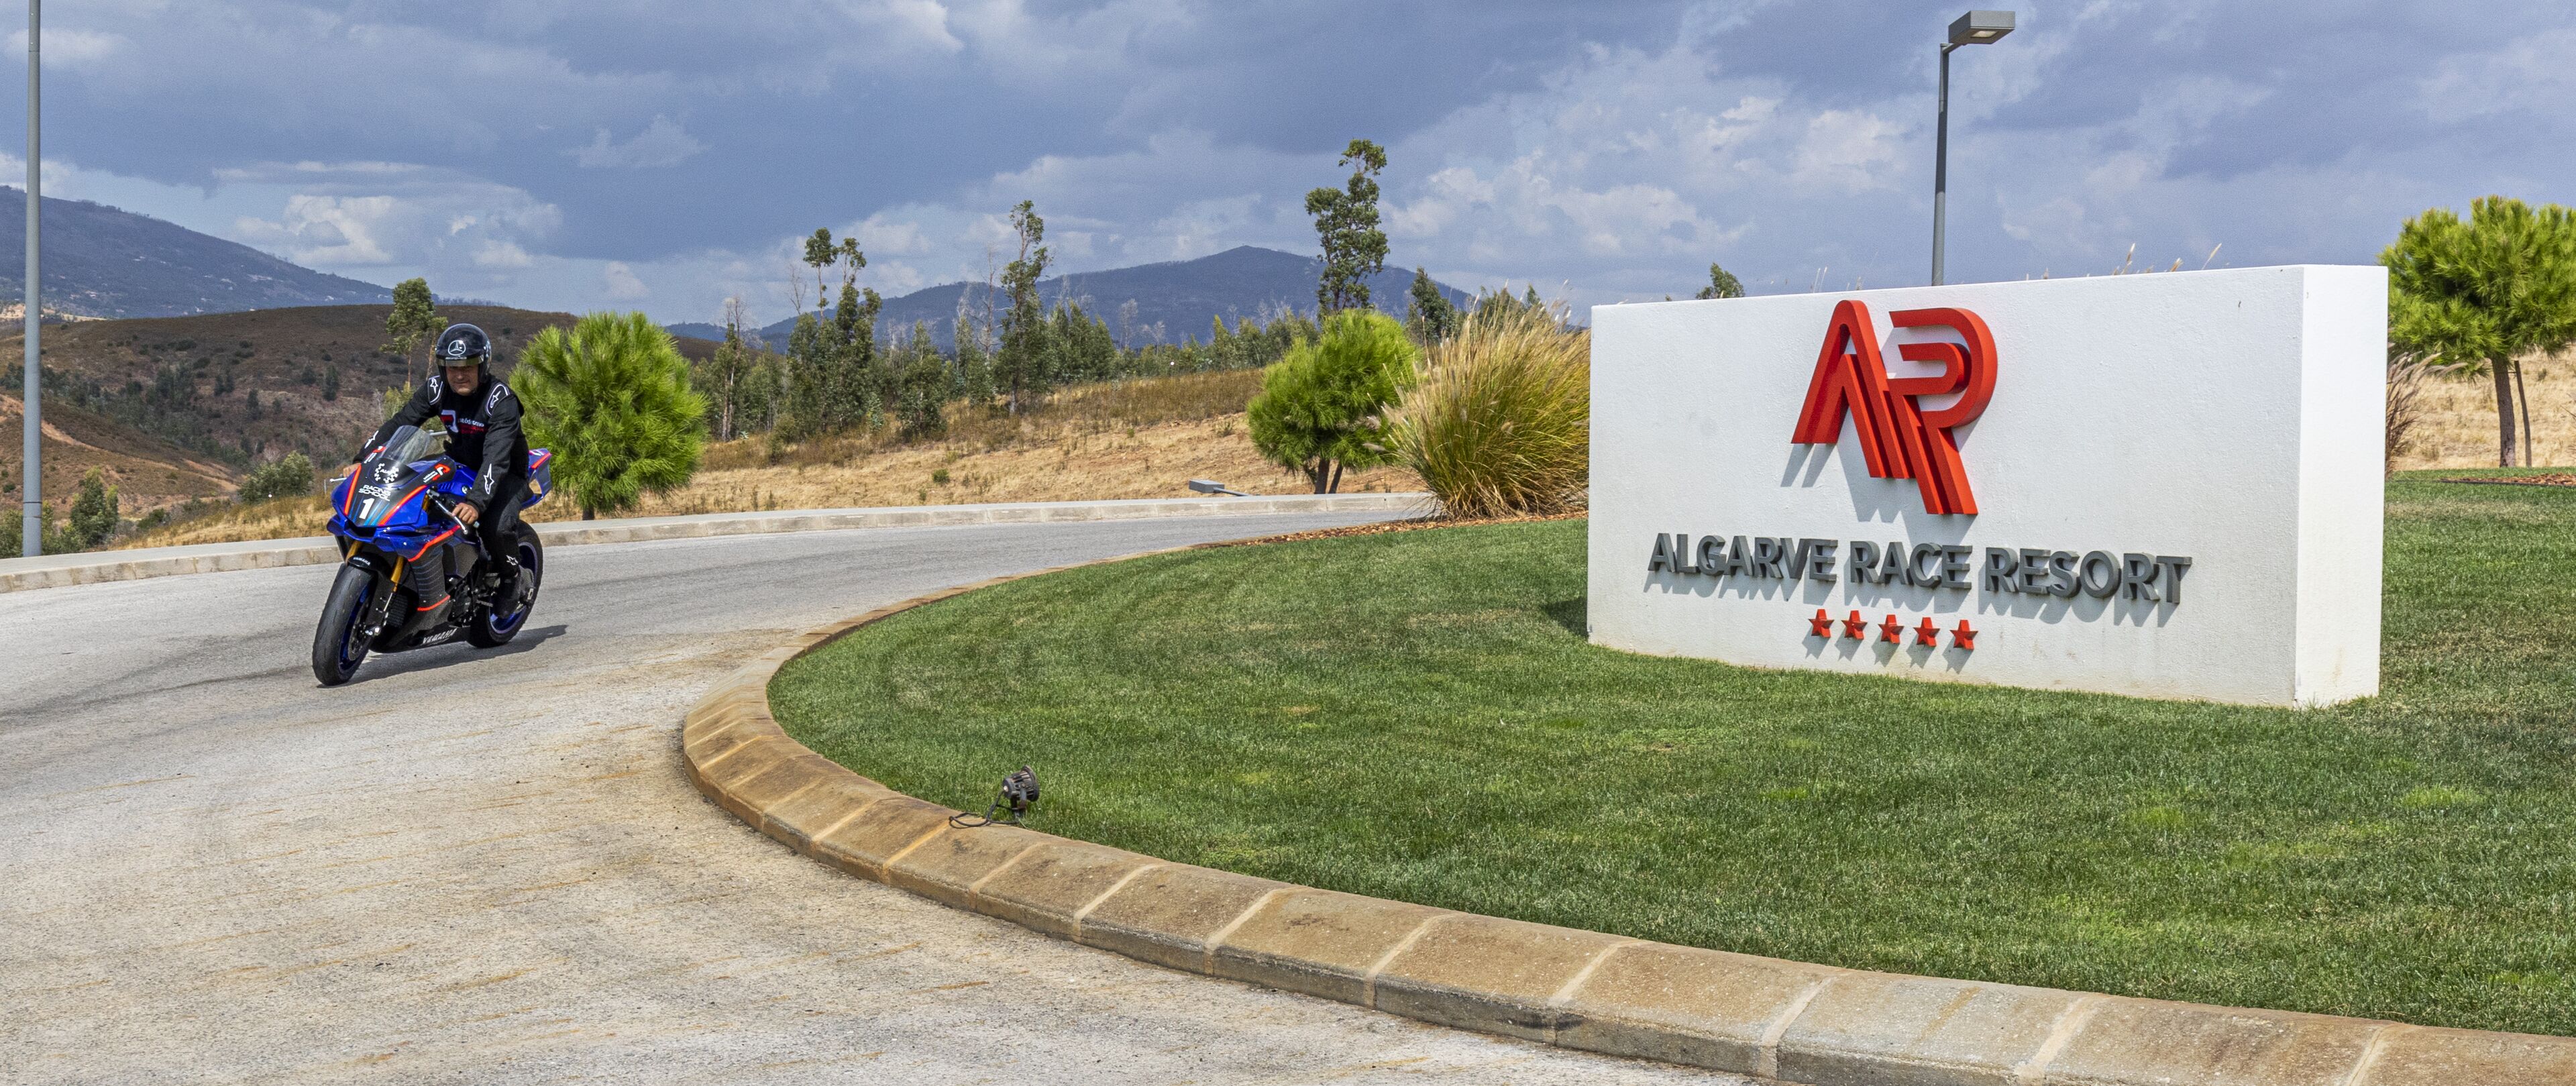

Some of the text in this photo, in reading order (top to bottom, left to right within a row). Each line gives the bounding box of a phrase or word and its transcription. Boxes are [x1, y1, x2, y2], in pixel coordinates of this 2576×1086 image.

[358, 488, 390, 502] SCHOOL
[363, 484, 391, 496] RACING
[359, 498, 375, 520] 1
[1648, 533, 2192, 604] ALGARVE RACE RESORT
[423, 628, 458, 644] YAMAHA
